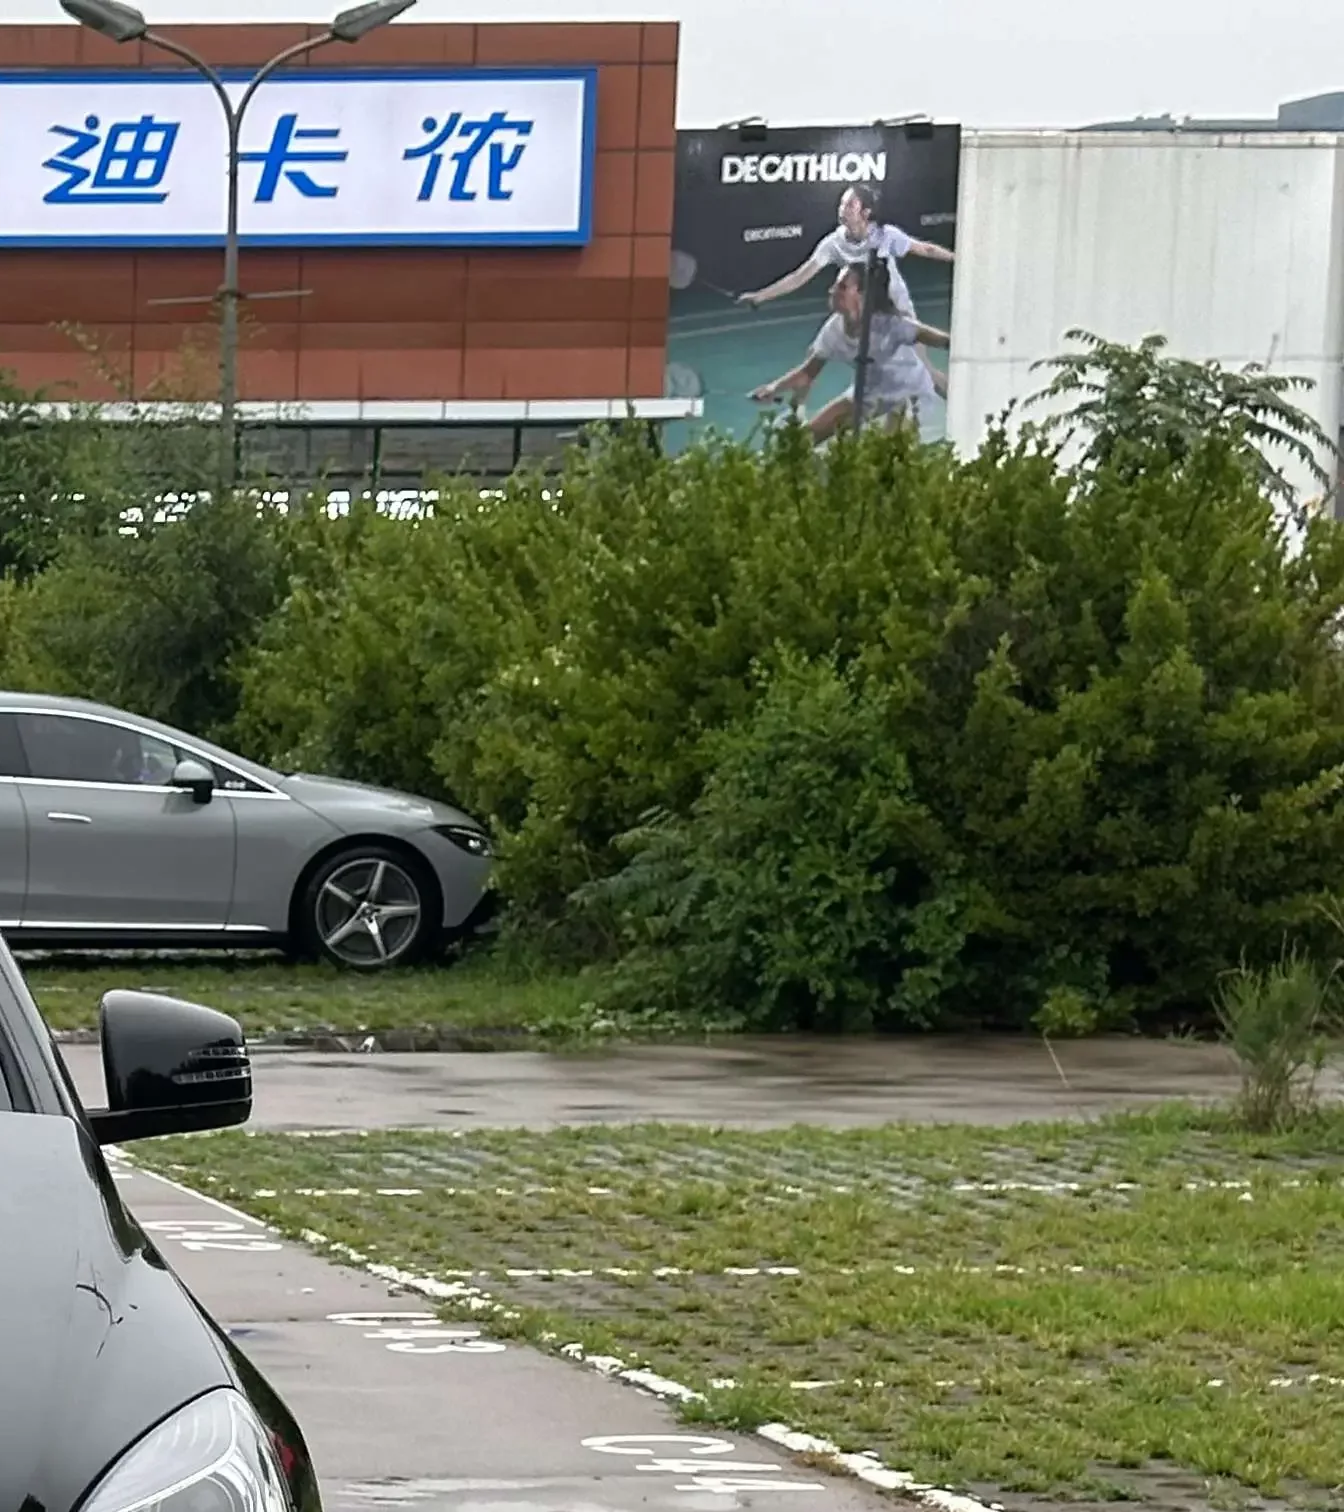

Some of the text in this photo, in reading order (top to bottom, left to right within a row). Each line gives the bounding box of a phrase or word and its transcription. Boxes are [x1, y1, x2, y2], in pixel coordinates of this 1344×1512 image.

[43, 111, 533, 203] 迪卡侬
[721, 152, 887, 184] DECATHLON
